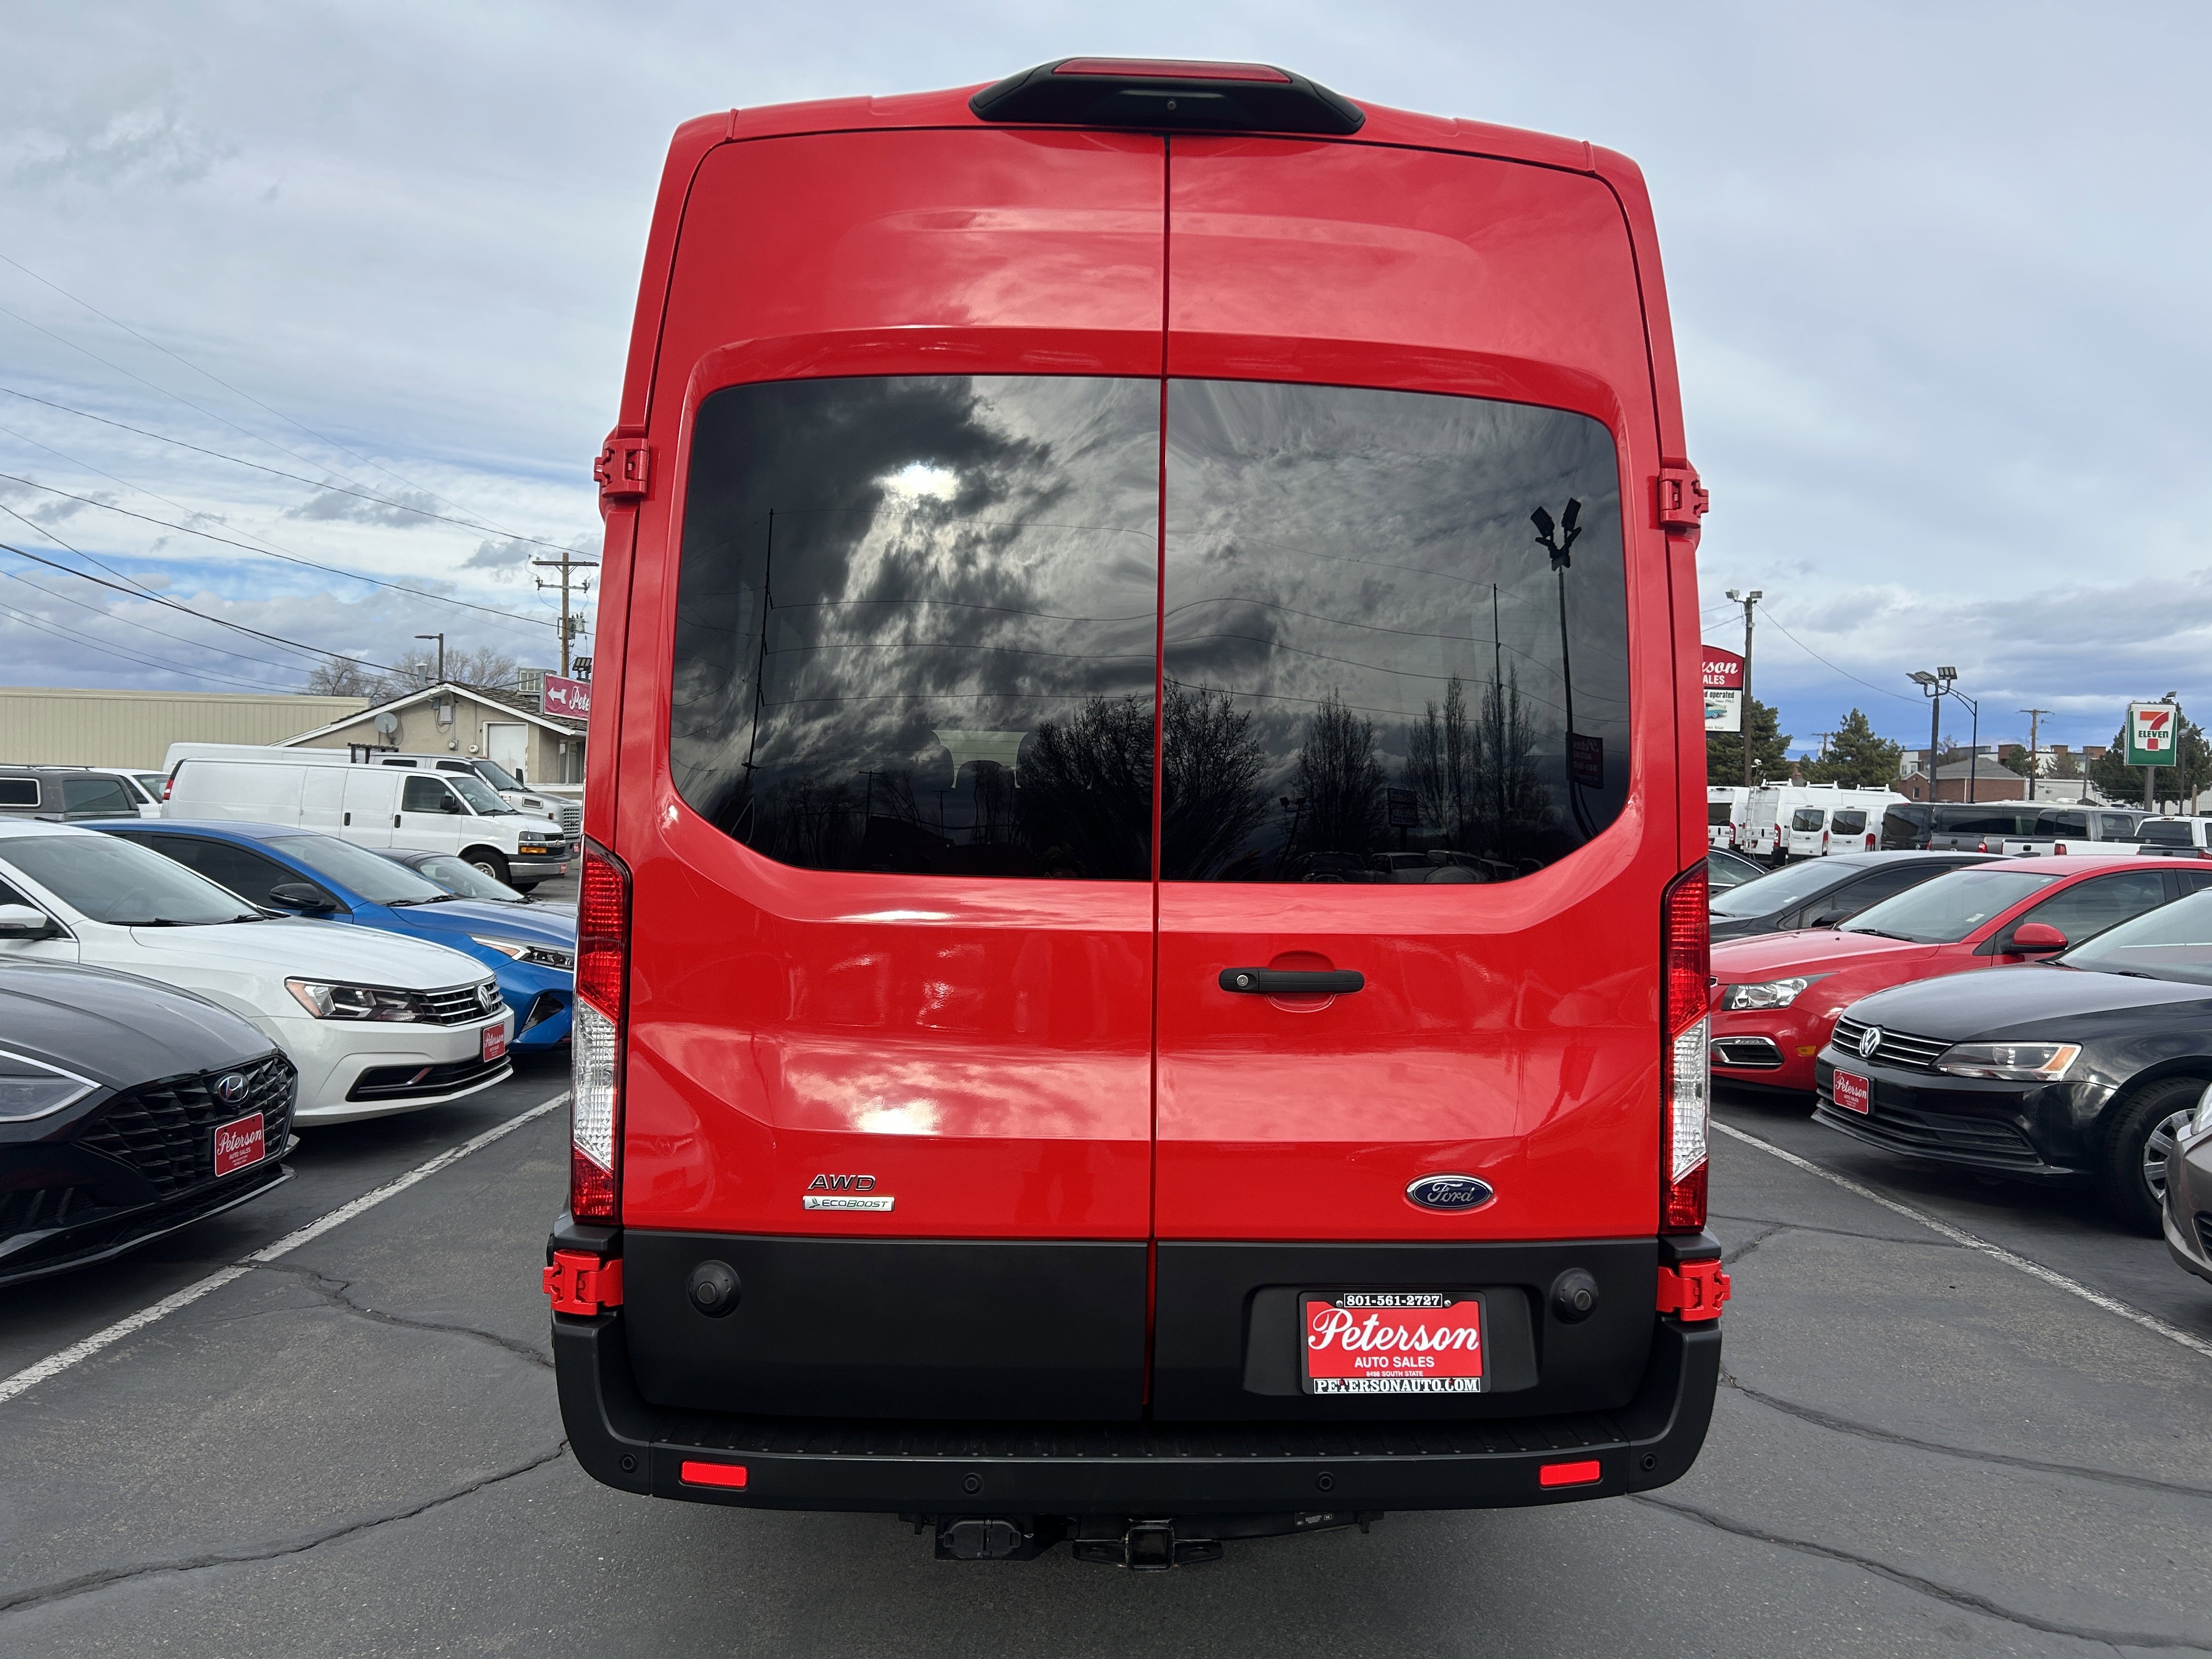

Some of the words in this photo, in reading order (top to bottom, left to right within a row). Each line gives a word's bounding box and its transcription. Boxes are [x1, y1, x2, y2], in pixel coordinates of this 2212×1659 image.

[1836, 1076, 1867, 1099] Peterson
[217, 1130, 262, 1155] Peterson
[808, 1174, 876, 1190] AWD
[1427, 1182, 1475, 1202] Ford
[1347, 1295, 1440, 1306] 801-561-2727
[1308, 1308, 1480, 1351] Peterson
[1355, 1356, 1389, 1368] AUTO
[1393, 1356, 1435, 1368] SALES
